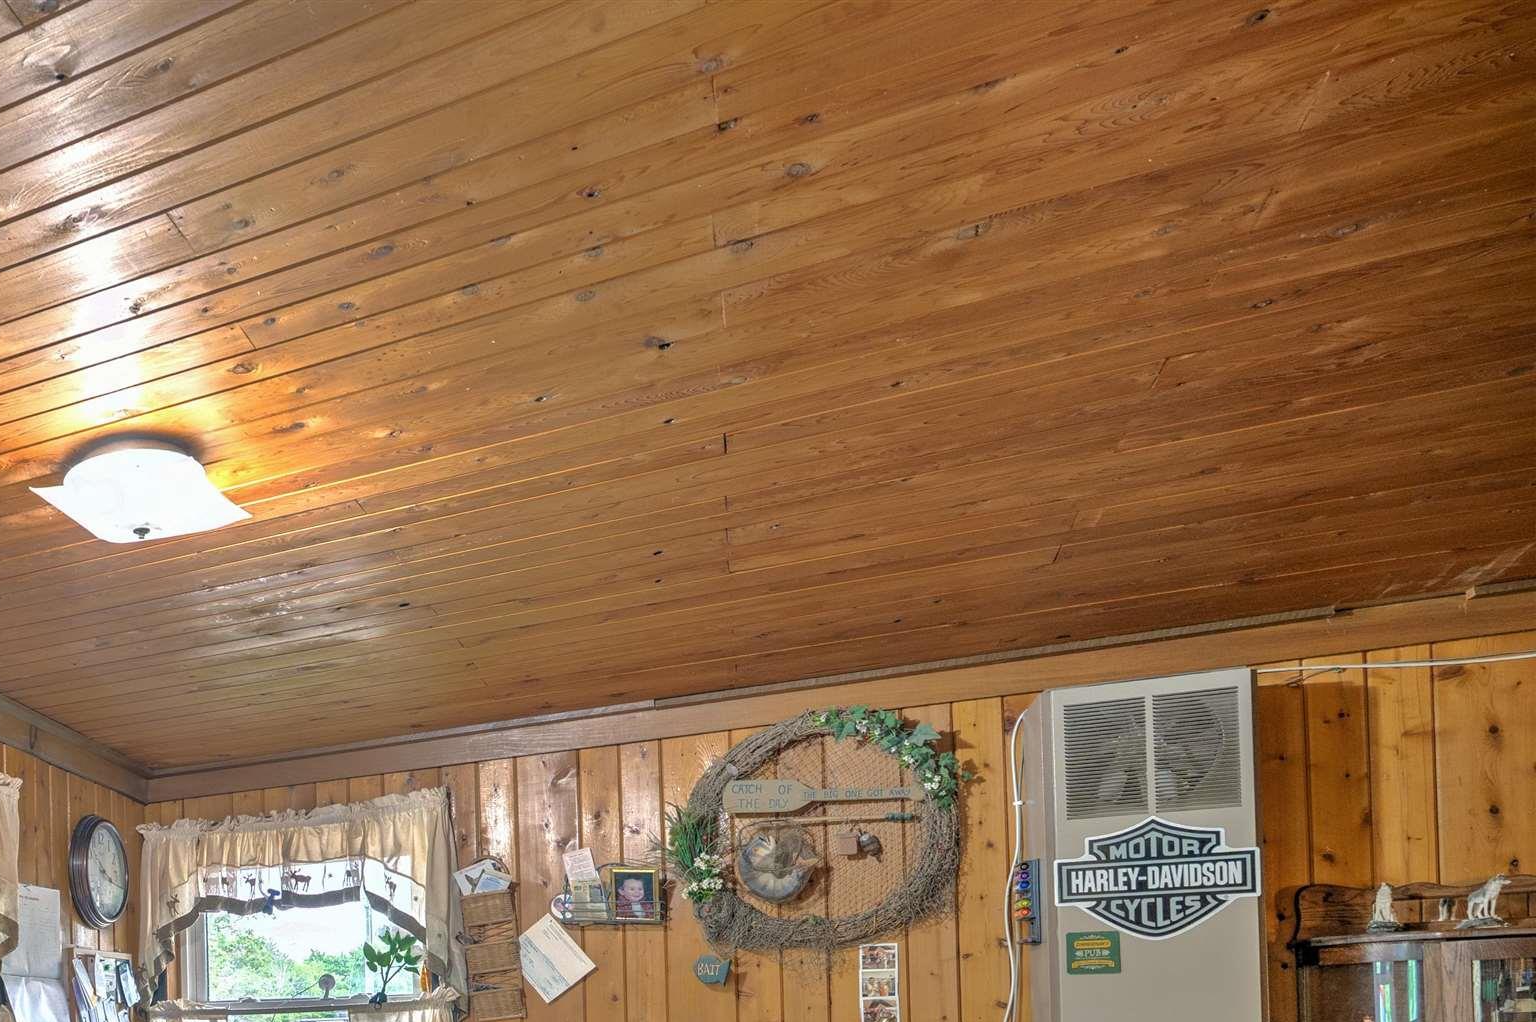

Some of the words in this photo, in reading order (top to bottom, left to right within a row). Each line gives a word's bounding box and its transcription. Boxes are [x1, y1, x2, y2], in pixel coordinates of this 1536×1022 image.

[777, 783, 792, 795] OF
[823, 790, 839, 799] BIG
[844, 789, 863, 798] ONE
[866, 788, 884, 798] GOT
[737, 798, 760, 809] THE
[1109, 831, 1200, 860] MOTOR
[1070, 860, 1243, 894] HARLEY-DAVIDSON
[1110, 895, 1201, 928] CYCLES
[697, 962, 721, 976] BAIT
